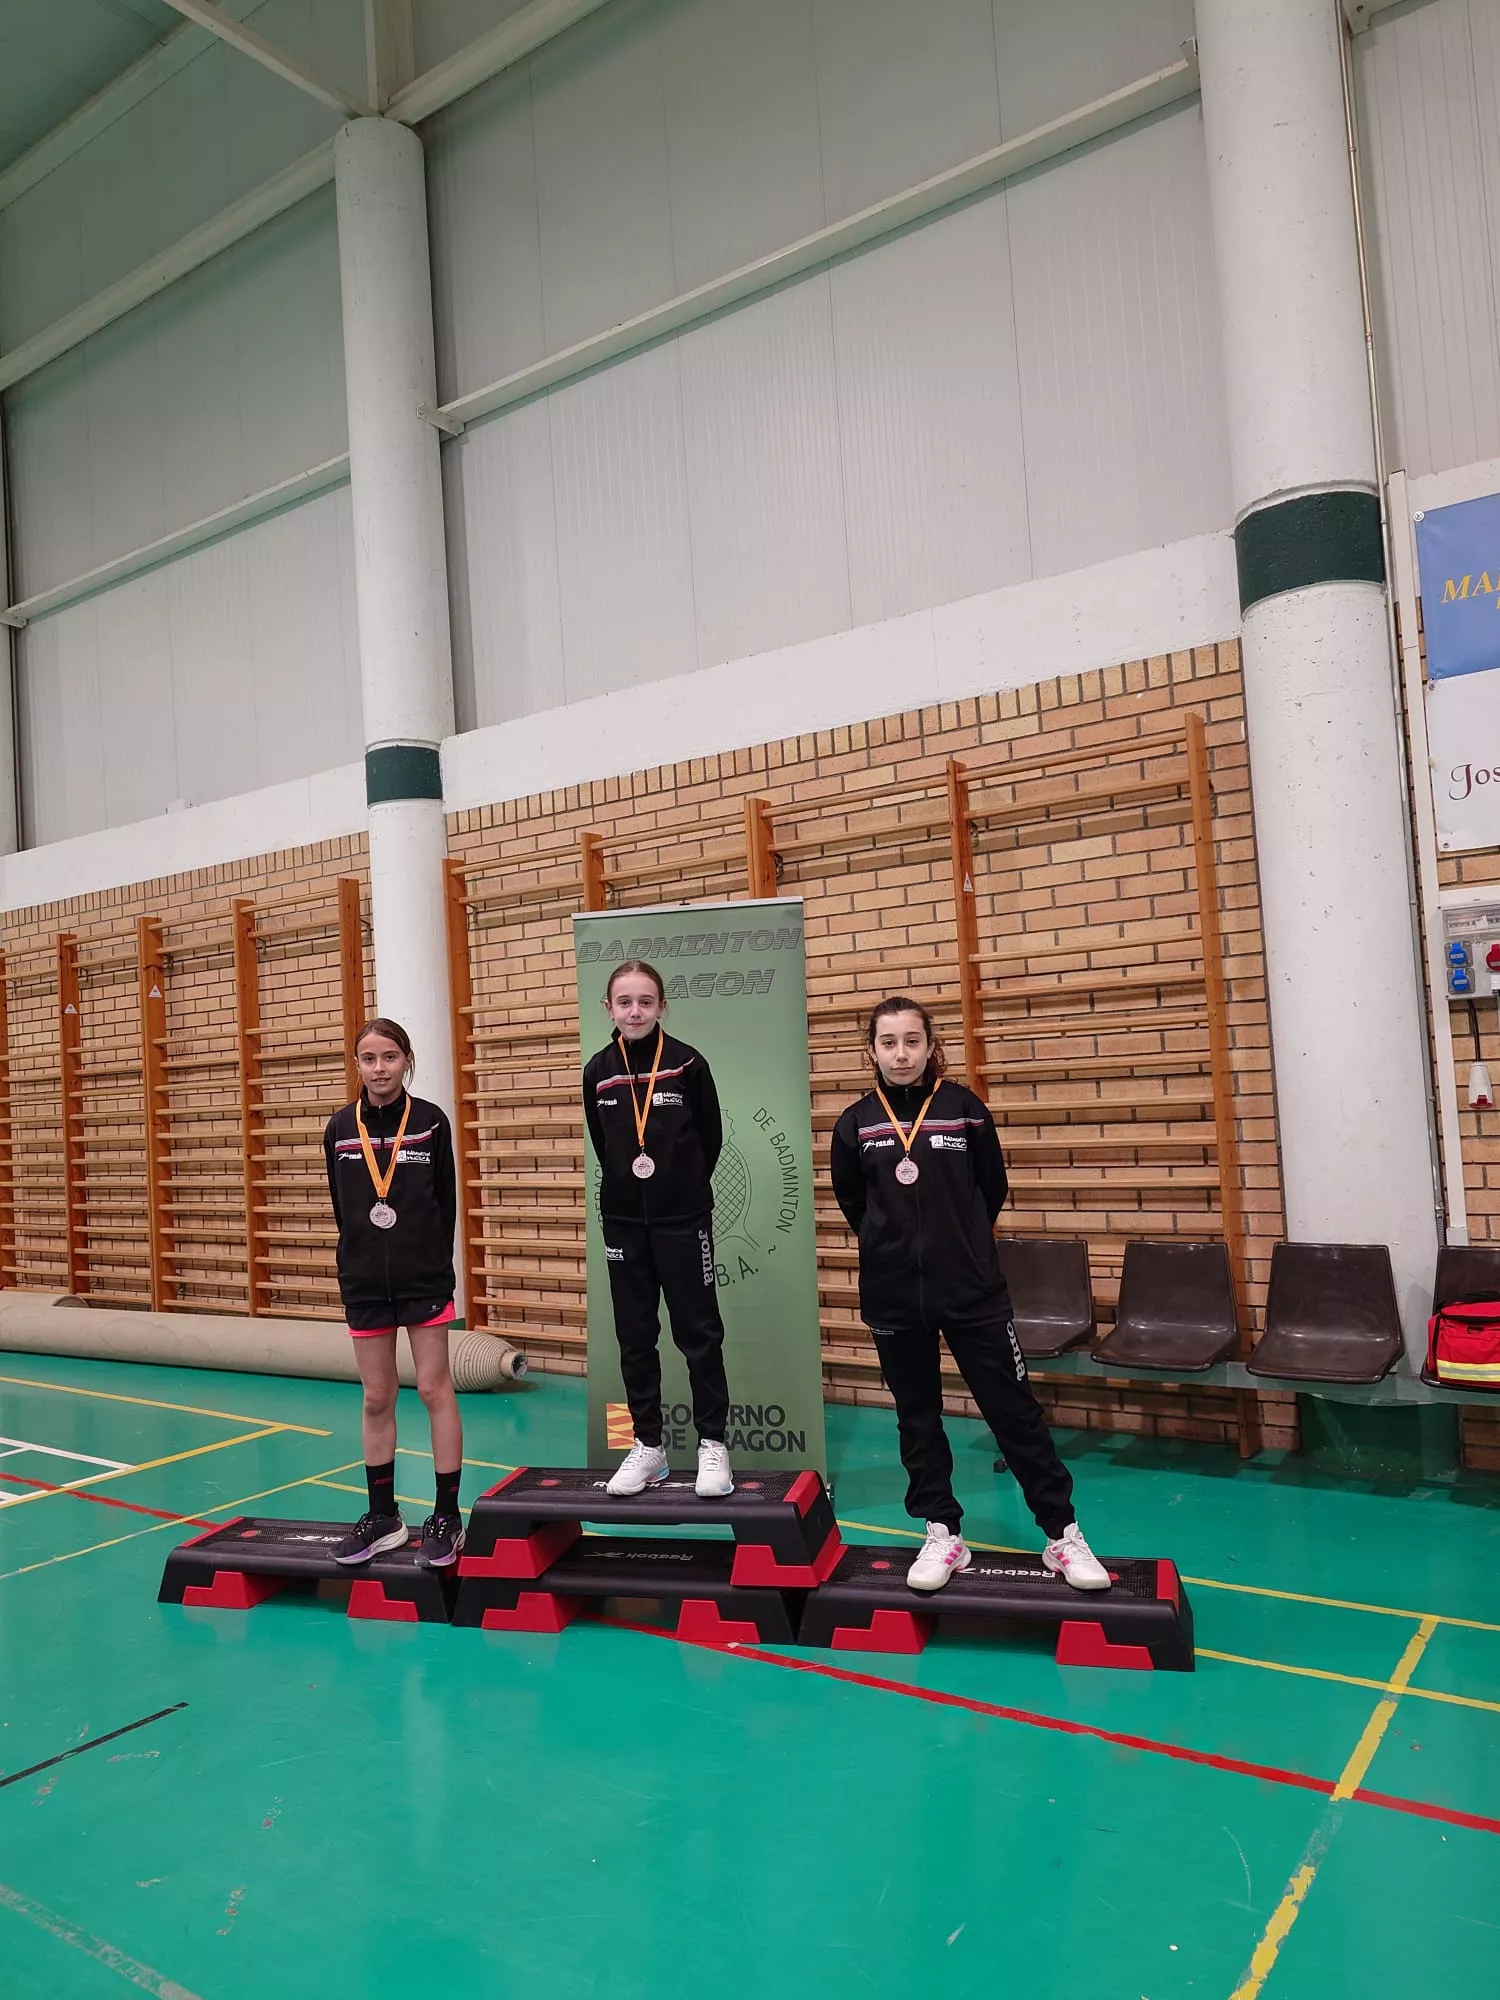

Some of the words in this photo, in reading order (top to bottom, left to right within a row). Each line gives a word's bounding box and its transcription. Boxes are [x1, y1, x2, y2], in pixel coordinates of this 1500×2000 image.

[1441, 570, 1500, 605] MA
[577, 927, 802, 964] BADMINTON
[600, 968, 776, 1003] AGON
[752, 1107, 777, 1132] DE
[769, 1131, 800, 1234] BADMINTON
[698, 1229, 714, 1286] Joma
[1006, 1320, 1026, 1381] oma
[980, 1567, 1056, 1578] Reebok
